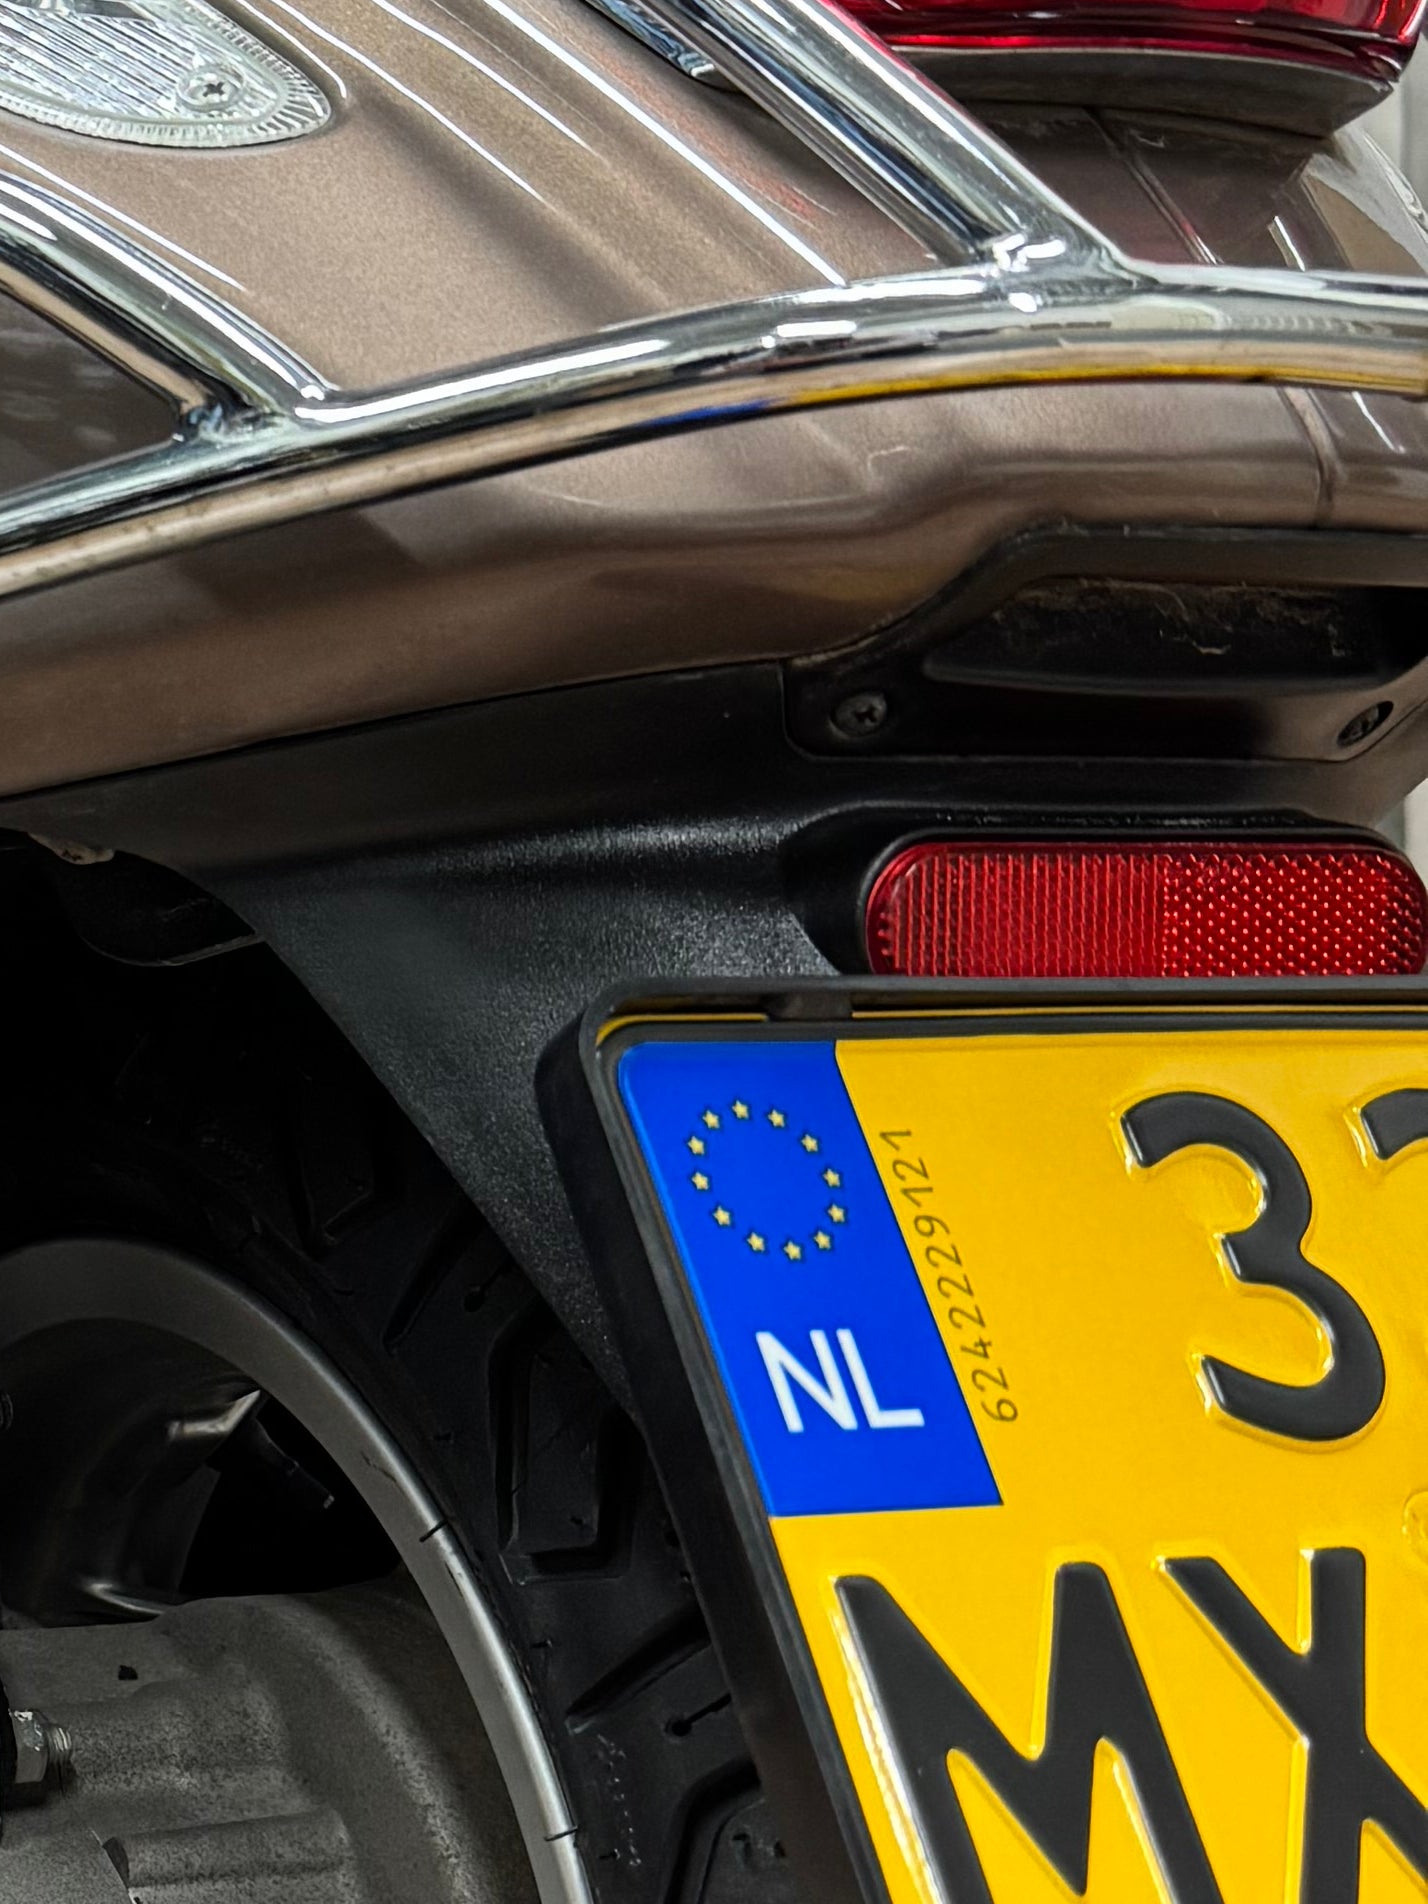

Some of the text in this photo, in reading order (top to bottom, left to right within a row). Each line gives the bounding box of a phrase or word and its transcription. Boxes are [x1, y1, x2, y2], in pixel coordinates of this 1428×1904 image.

[754, 1326, 926, 1435] NL
[878, 1128, 1019, 1424] 6242229121
[1118, 1087, 1428, 1443] 3
